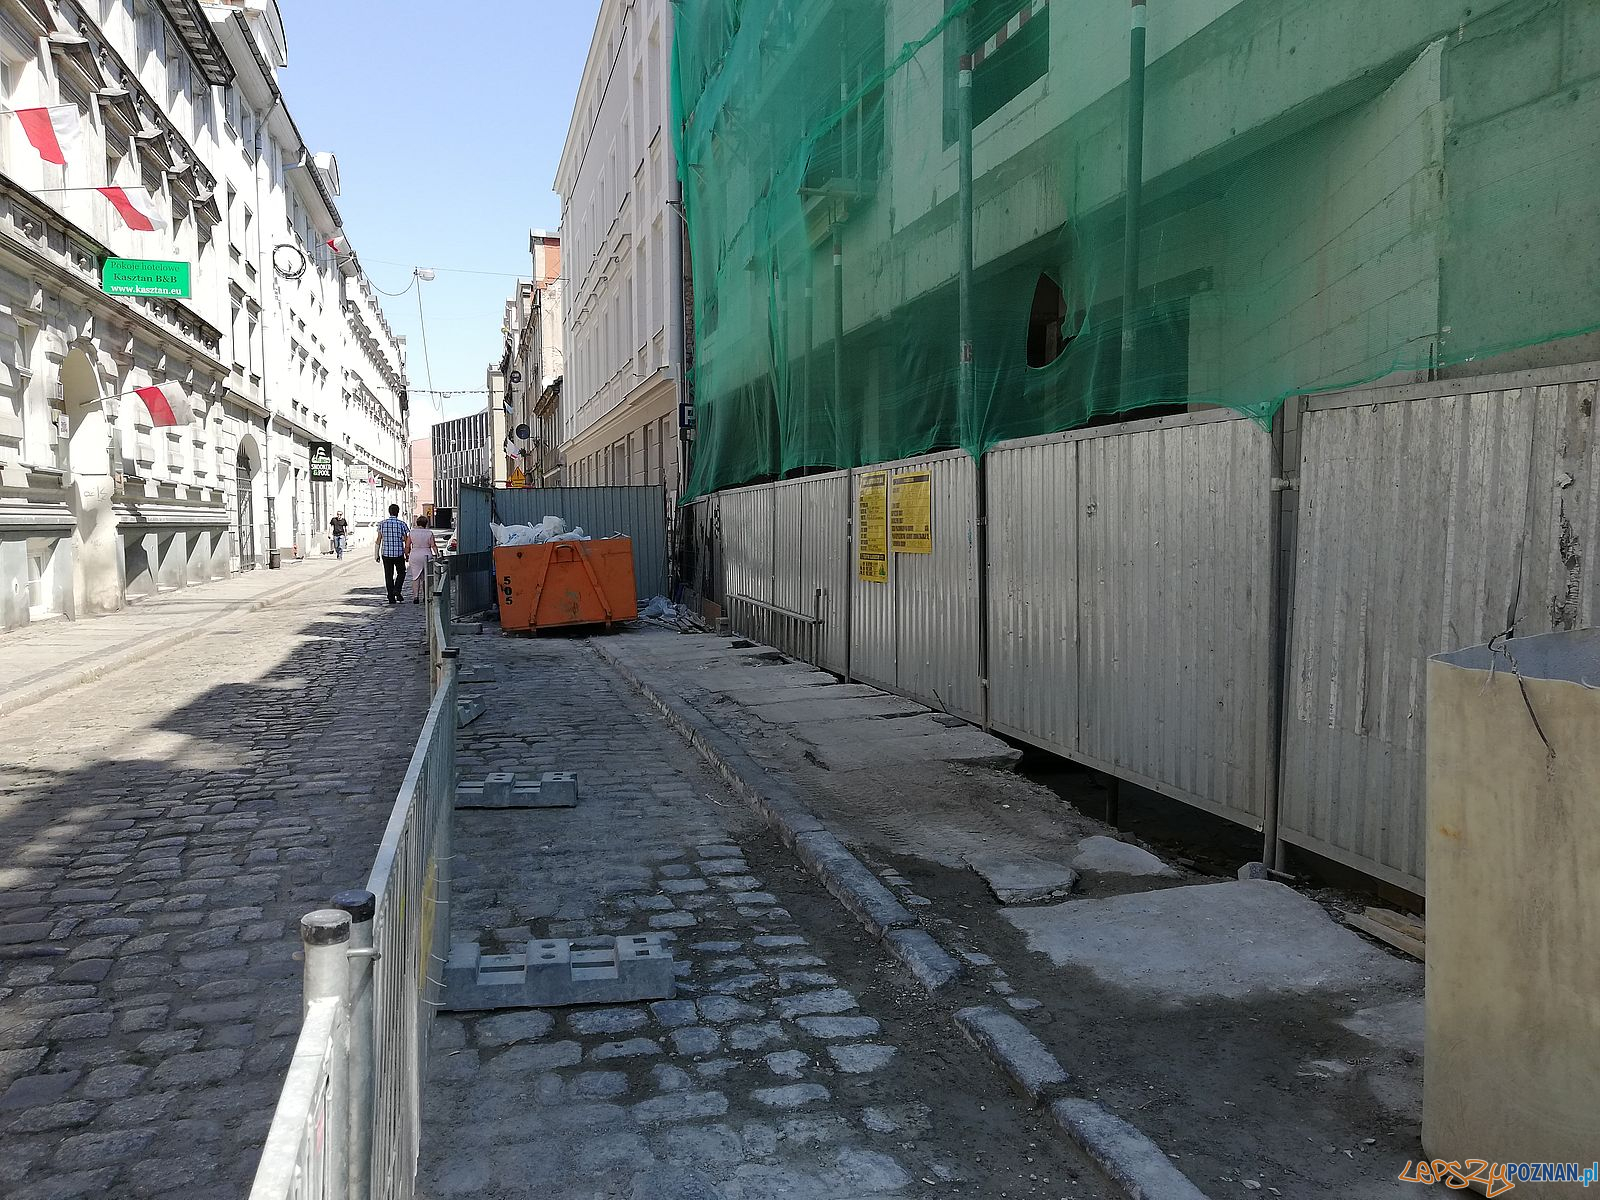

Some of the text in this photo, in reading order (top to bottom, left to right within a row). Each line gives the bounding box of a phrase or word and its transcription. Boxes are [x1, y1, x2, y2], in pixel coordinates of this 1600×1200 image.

[111, 261, 180, 272] Pokoje hotelowe
[113, 273, 177, 283] Kasztan B&B
[110, 285, 182, 295] www.kasztan.eu
